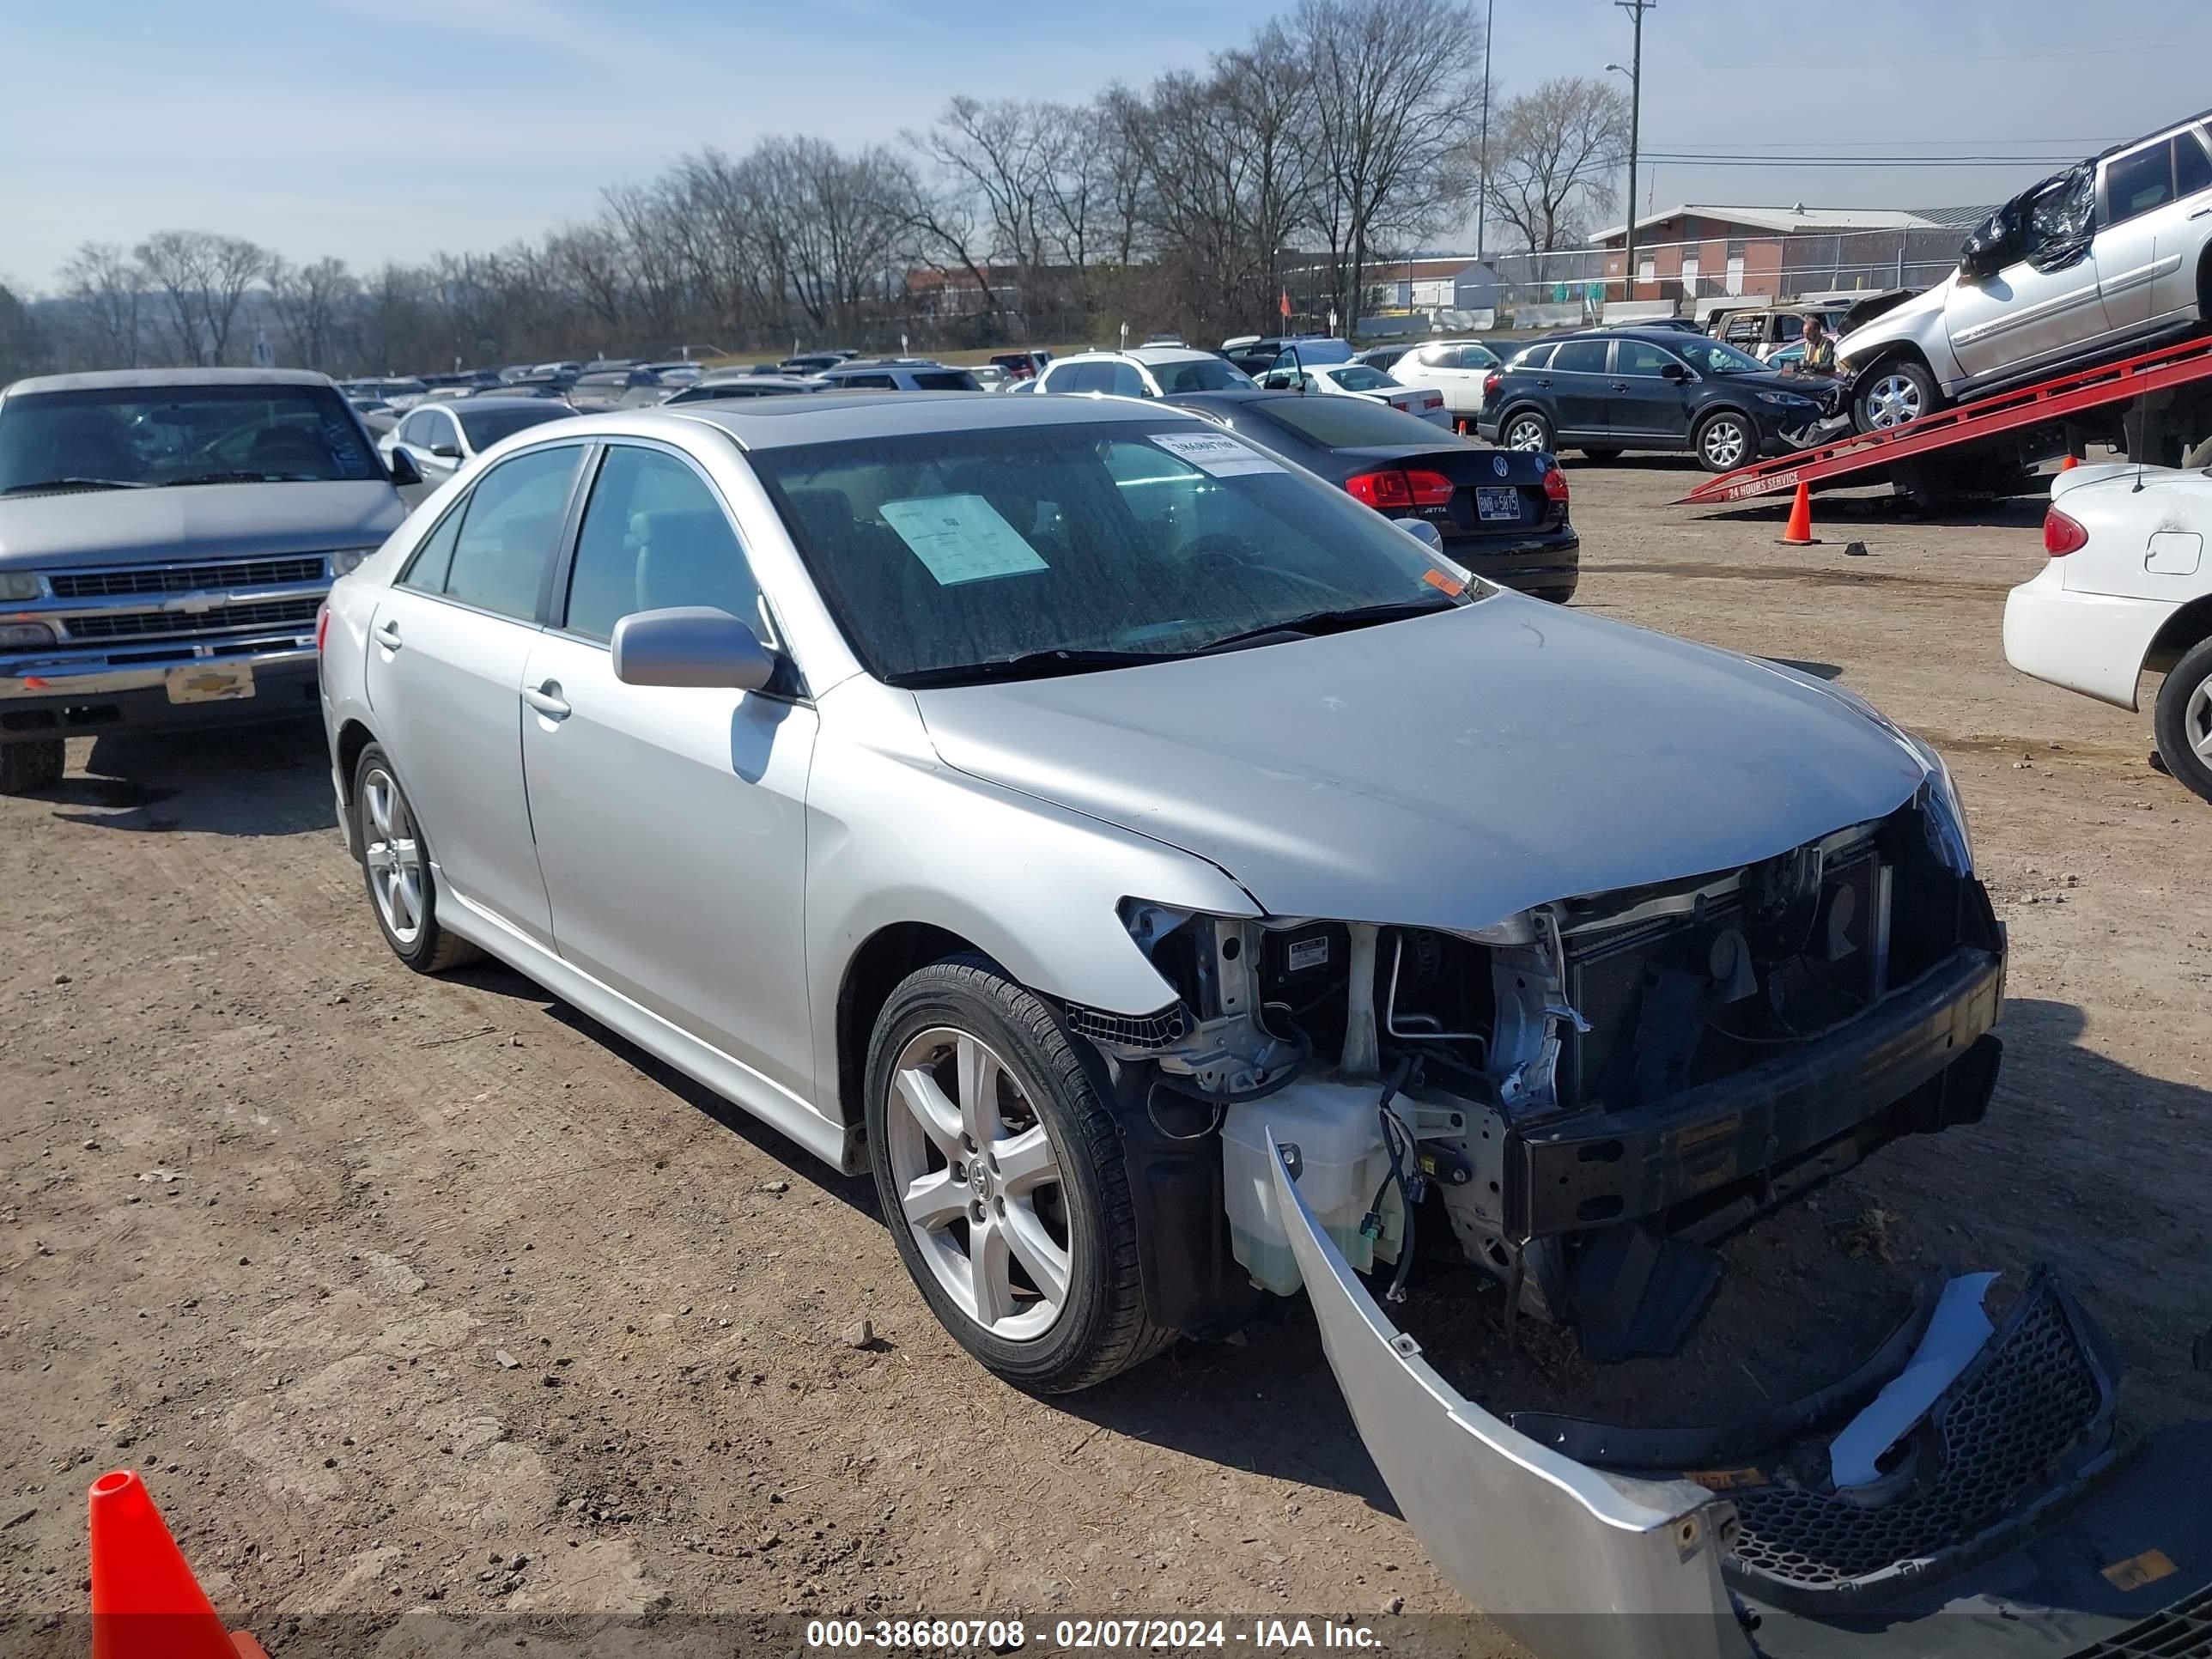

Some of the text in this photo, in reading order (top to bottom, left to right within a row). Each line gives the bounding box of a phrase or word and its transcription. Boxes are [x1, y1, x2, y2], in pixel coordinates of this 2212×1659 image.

[1729, 471, 1800, 499] 24 HOURS SERVICE
[1498, 495, 1517, 511] 5875
